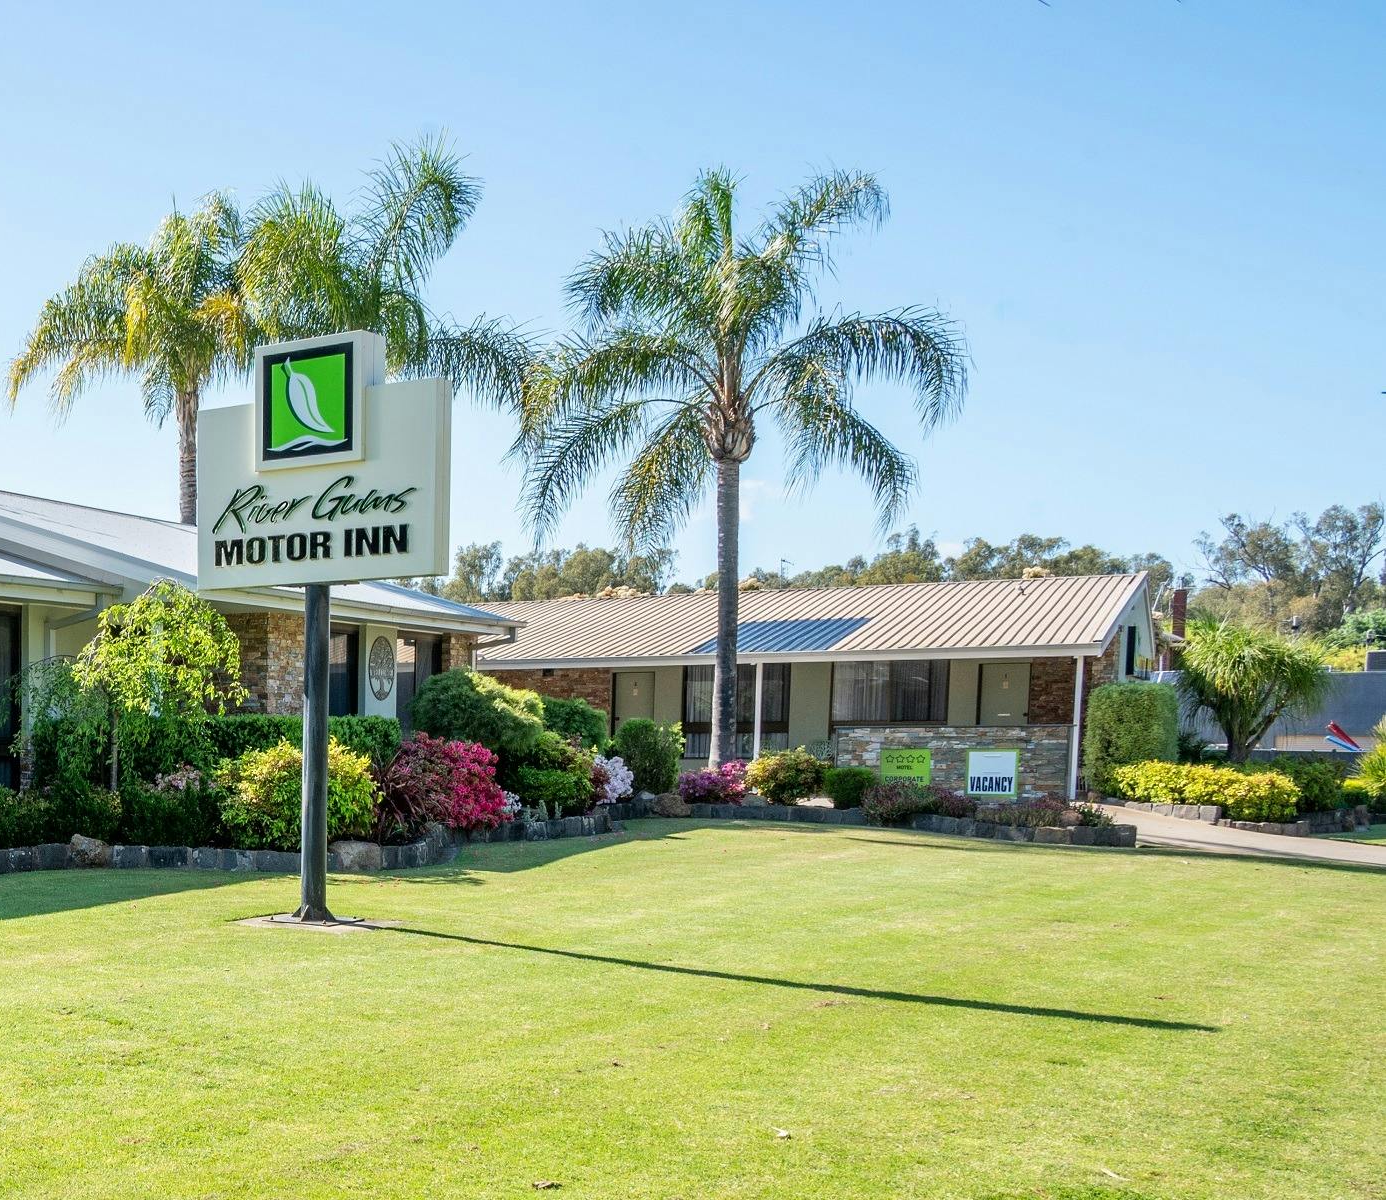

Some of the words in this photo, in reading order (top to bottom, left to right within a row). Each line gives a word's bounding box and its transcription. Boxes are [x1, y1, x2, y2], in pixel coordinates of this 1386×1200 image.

[212, 484, 313, 535] River
[311, 475, 419, 522] Gums
[214, 530, 331, 567] MOTOR
[344, 523, 409, 557] INN
[970, 776, 1013, 792] VACANCY
